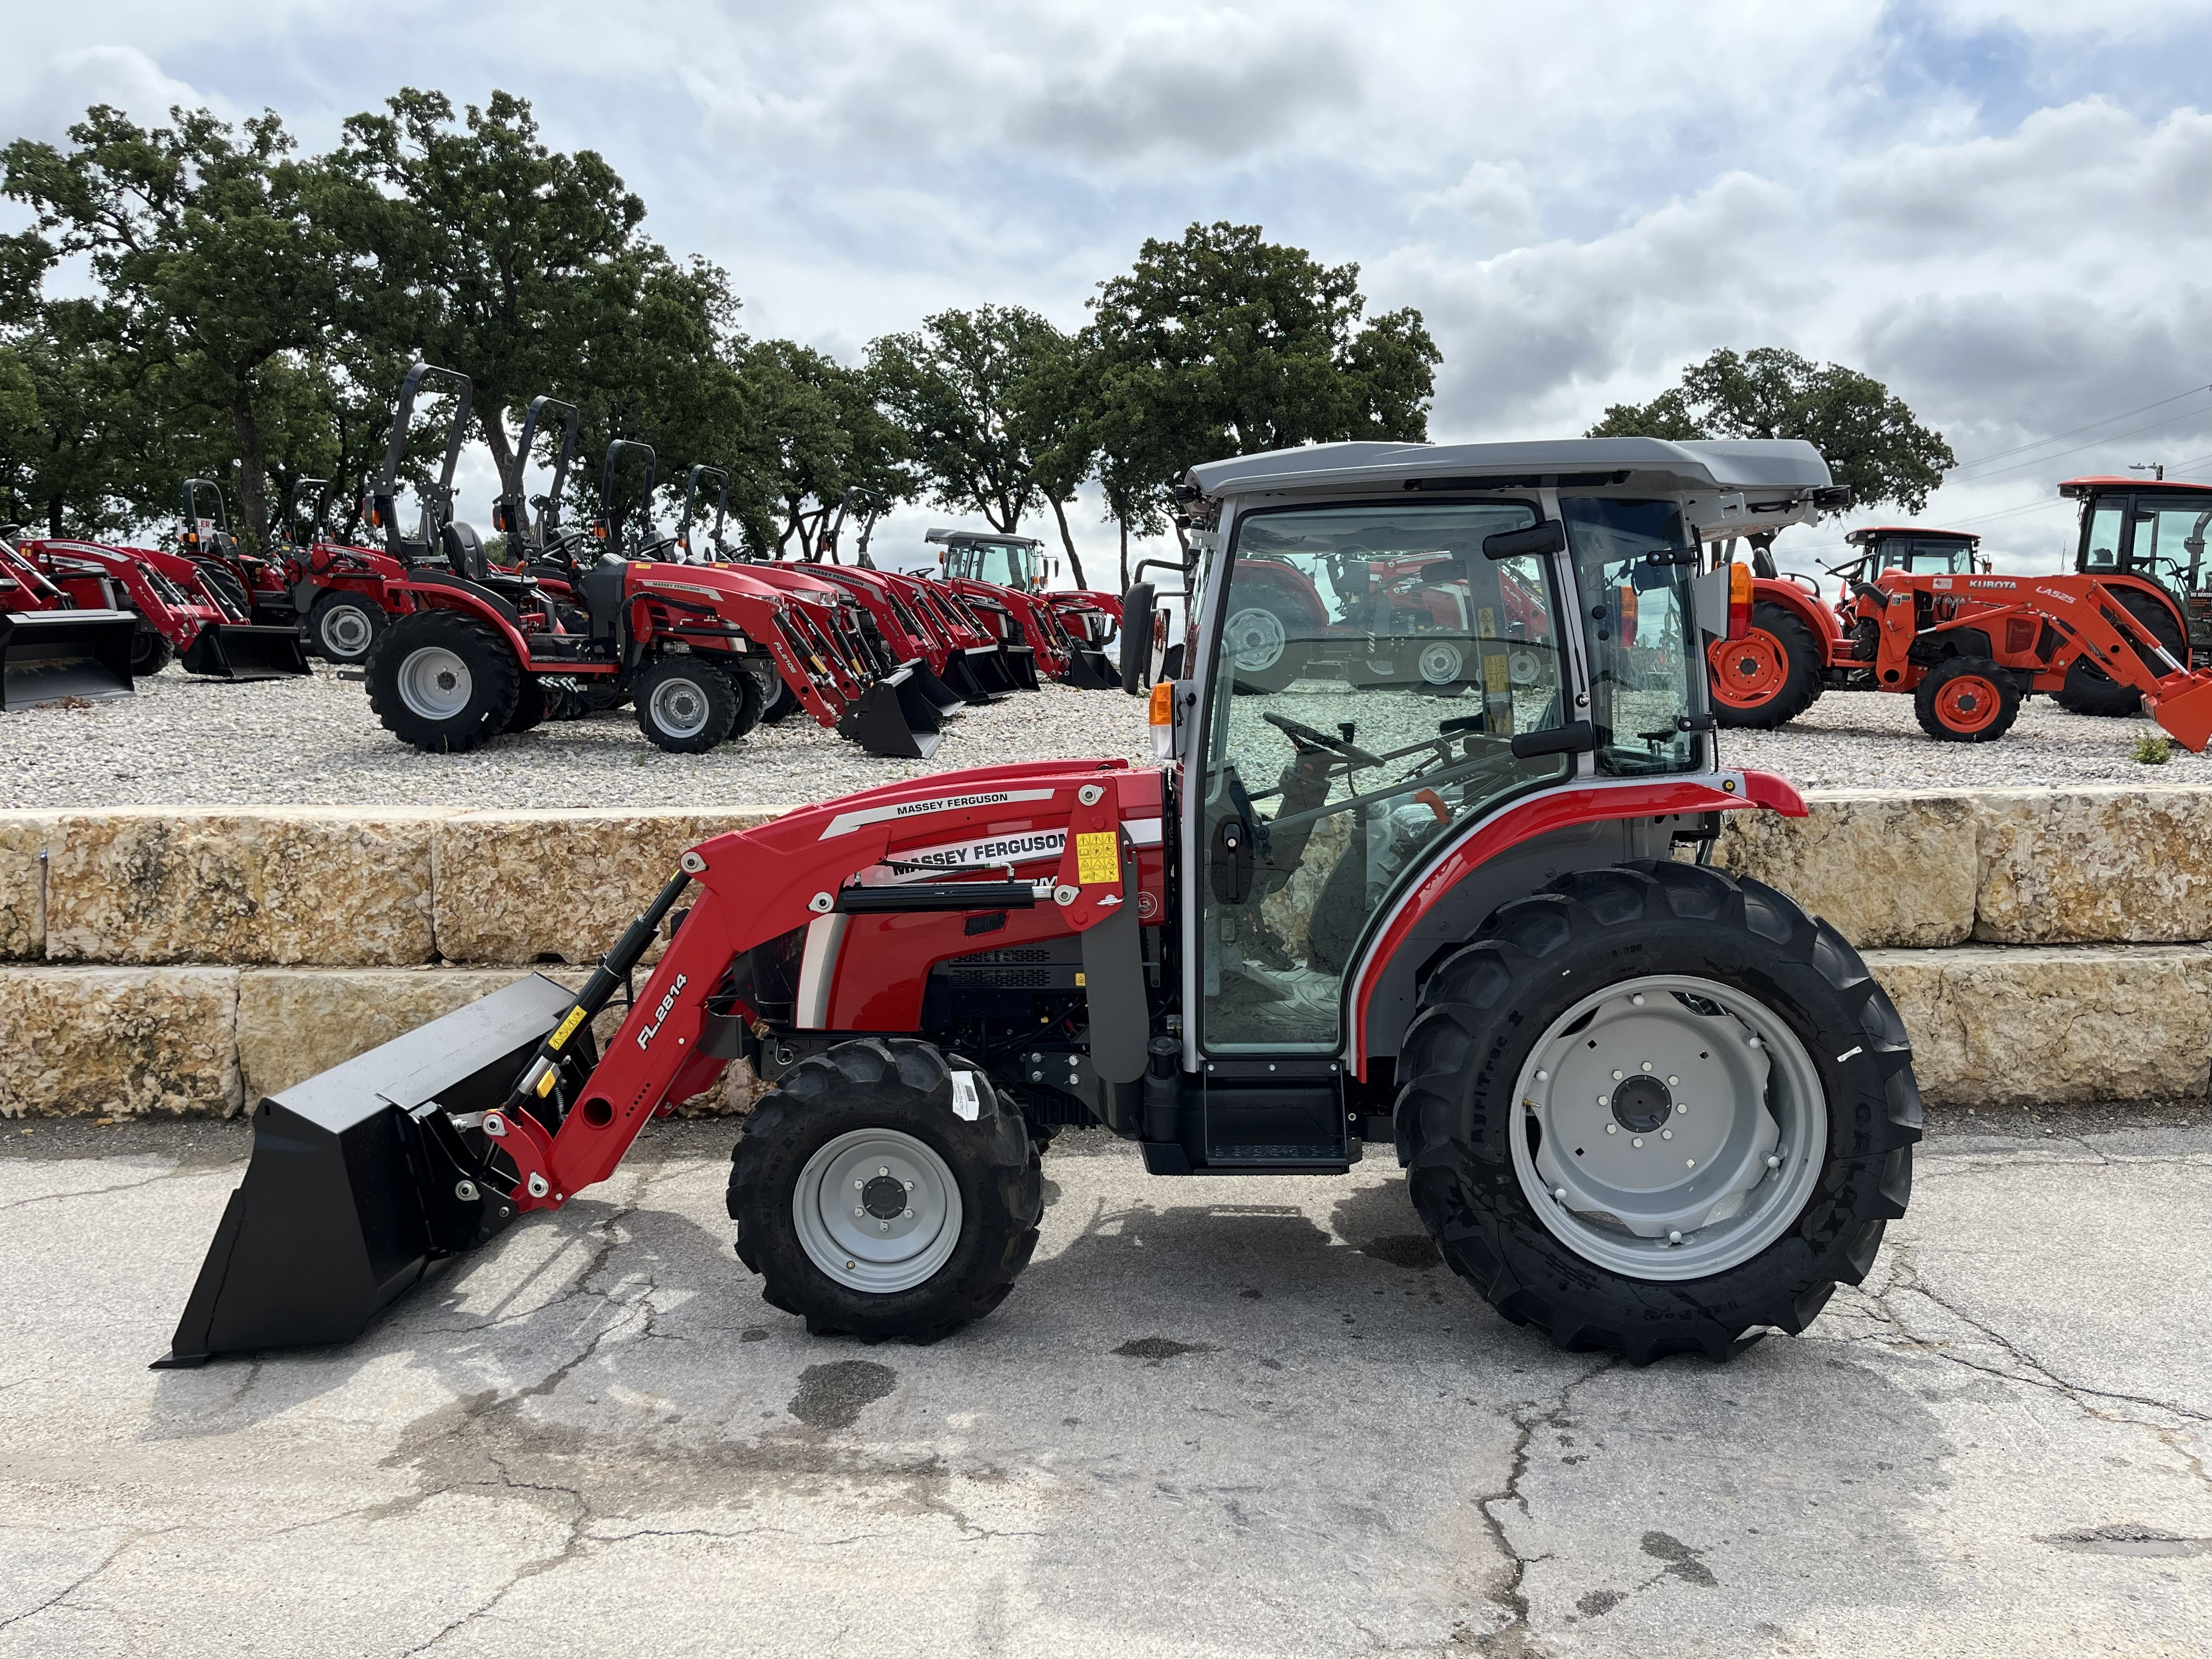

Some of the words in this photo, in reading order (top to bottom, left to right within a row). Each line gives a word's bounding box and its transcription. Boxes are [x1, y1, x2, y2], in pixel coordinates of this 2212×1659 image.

[84, 546, 112, 557] FERGUSON
[808, 568, 832, 577] MASSEY
[833, 574, 864, 586] FERGUSON
[1970, 580, 2017, 590] KUBOTA
[2035, 586, 2076, 603] LA525
[897, 800, 944, 815] MASSEY
[947, 793, 1008, 807] FERGUSON
[973, 833, 1068, 860] FERGUSON
[636, 972, 687, 1052] FL.2814
